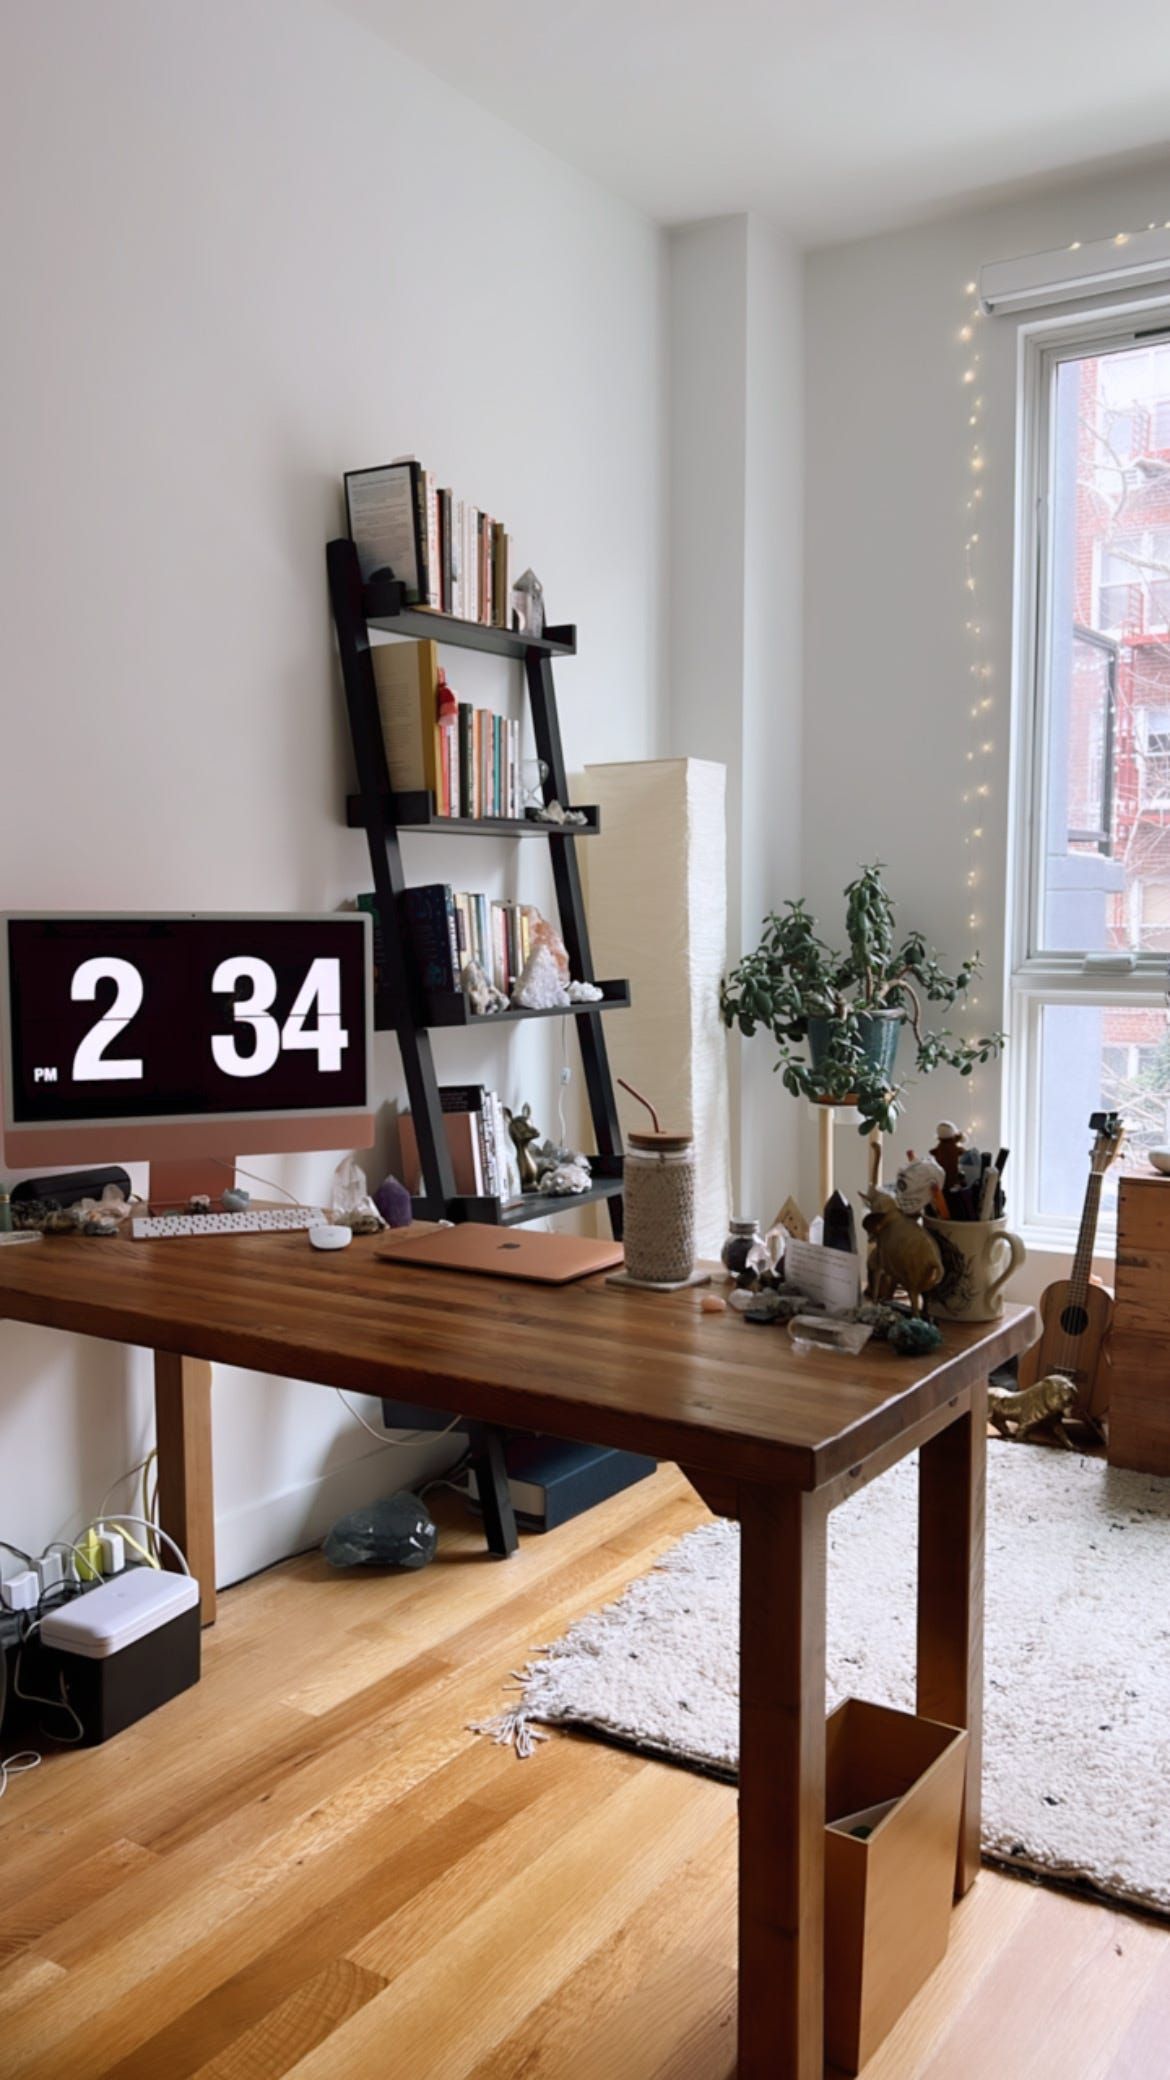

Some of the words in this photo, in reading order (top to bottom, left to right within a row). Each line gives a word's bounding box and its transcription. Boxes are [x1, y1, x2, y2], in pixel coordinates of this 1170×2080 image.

[71, 956, 144, 1081] 2
[211, 956, 349, 1077] 34
[34, 1067, 58, 1082] PM
